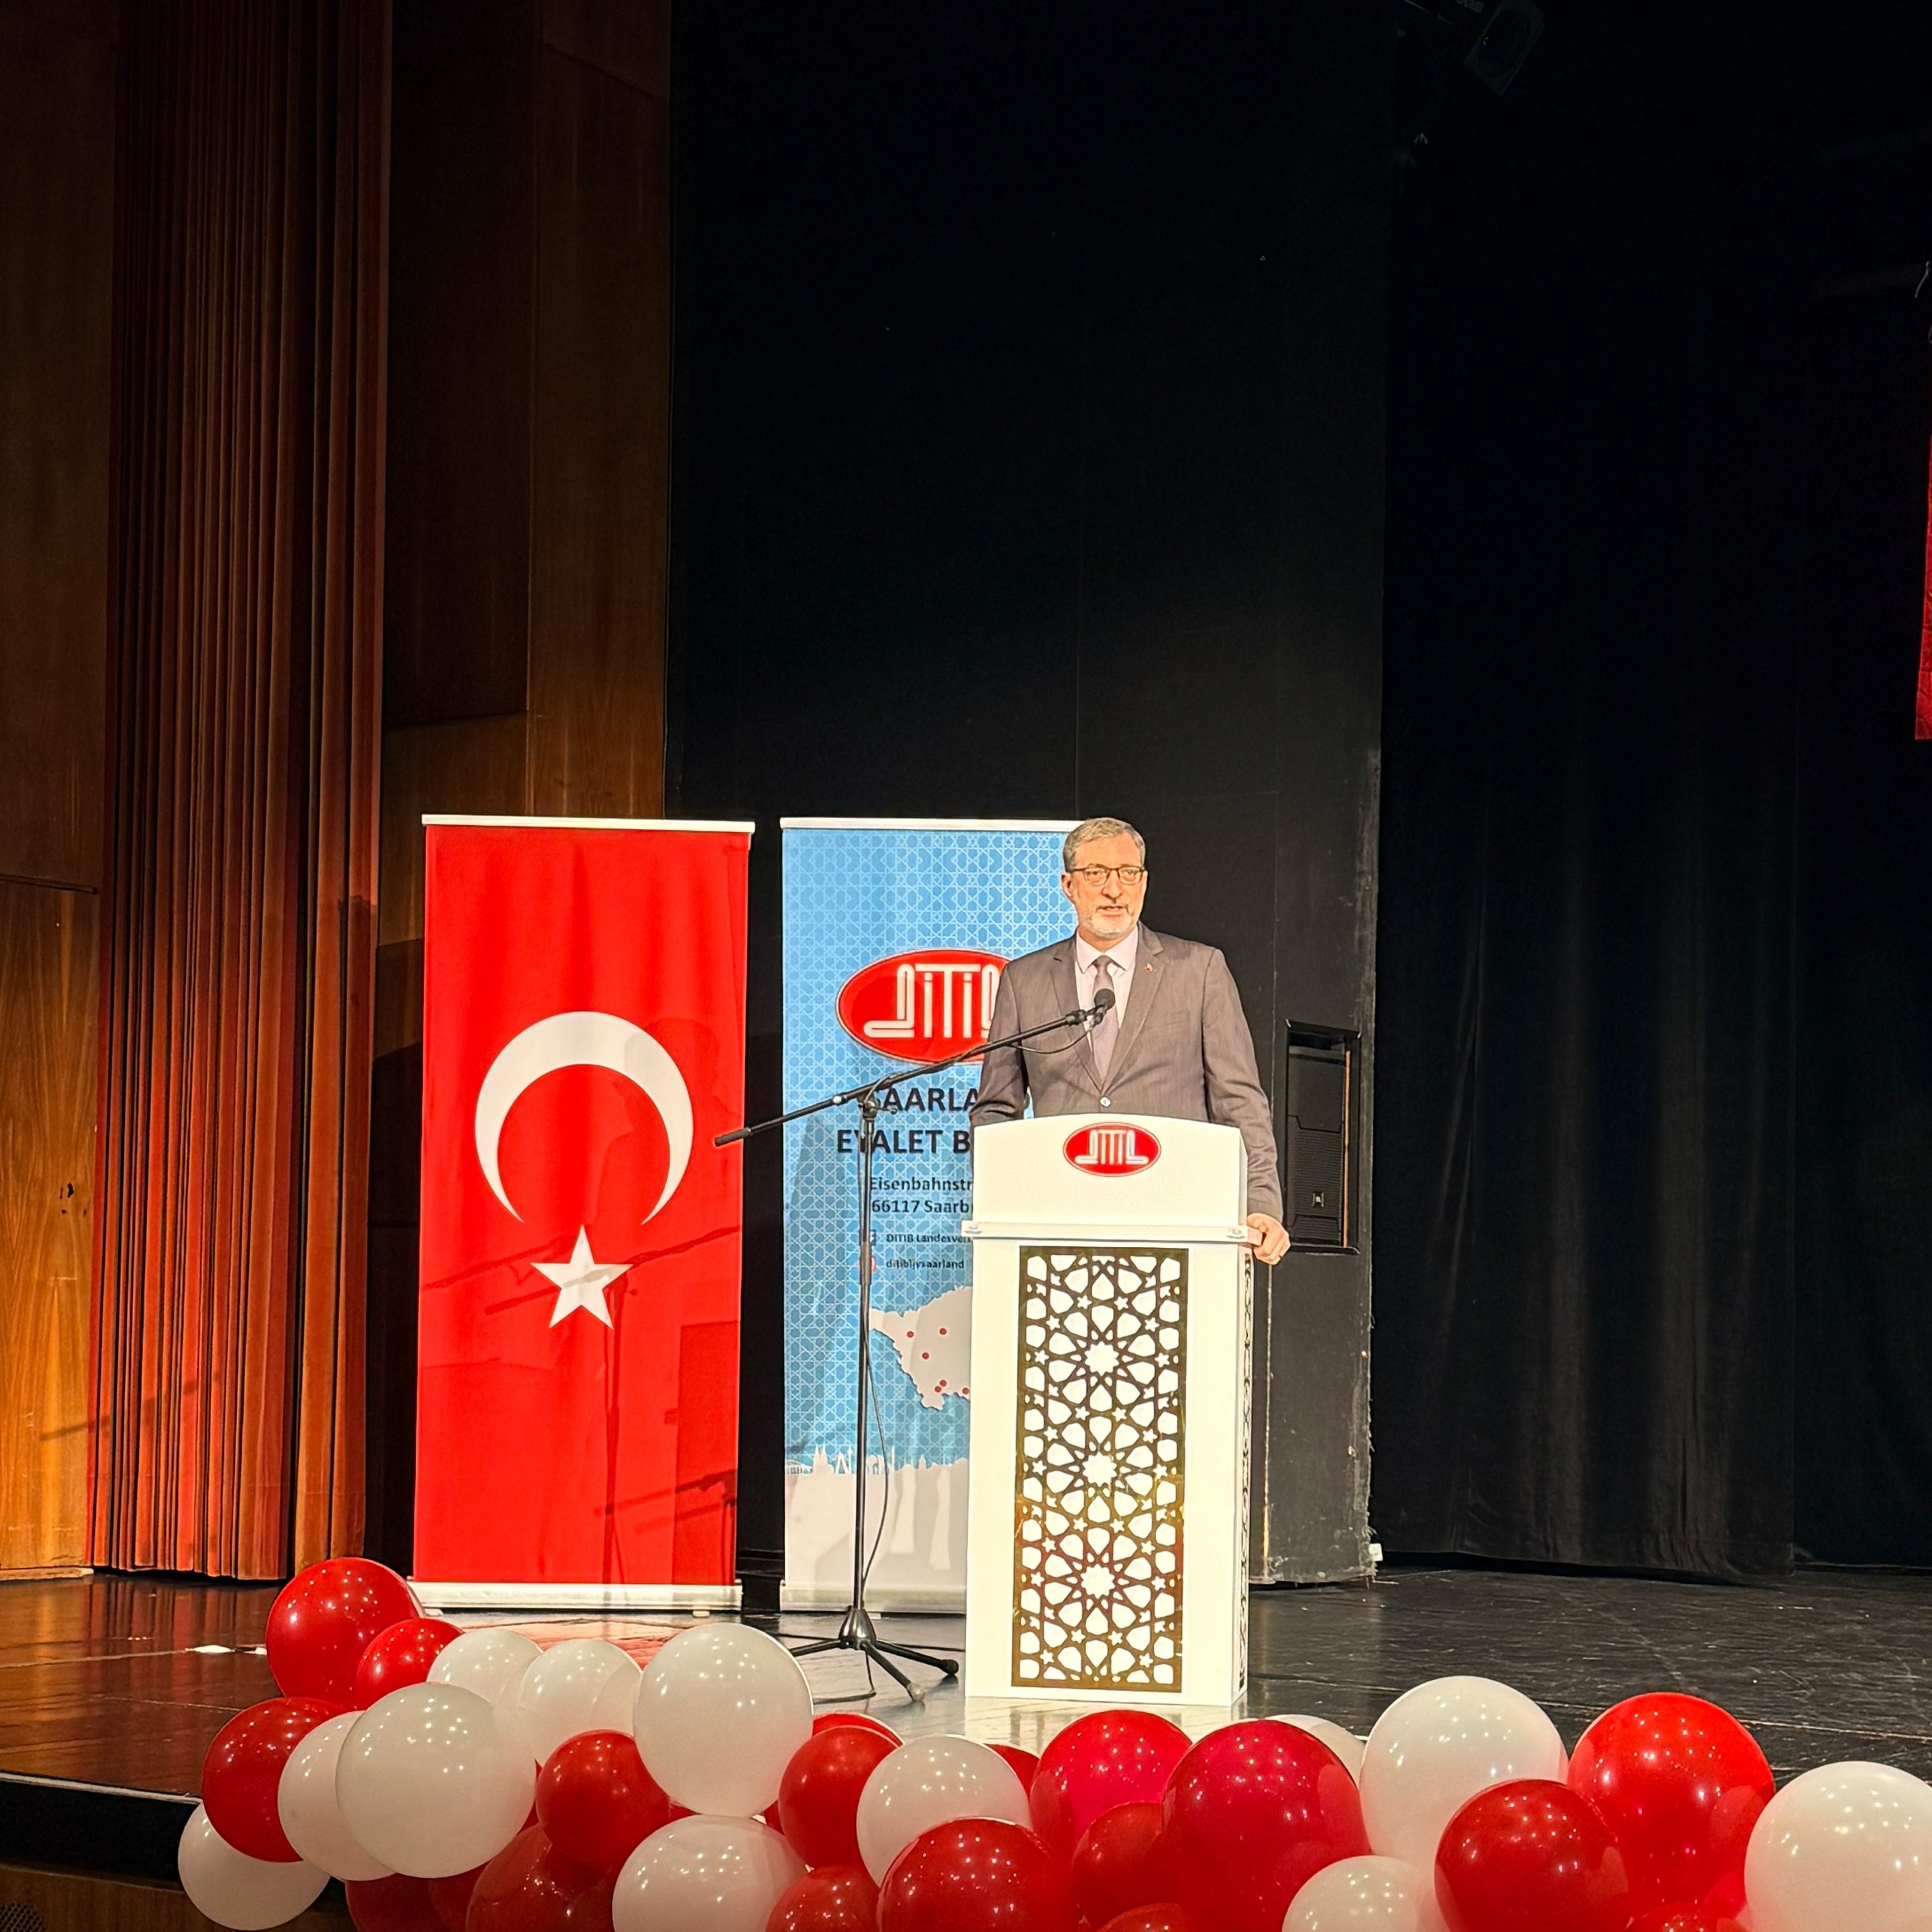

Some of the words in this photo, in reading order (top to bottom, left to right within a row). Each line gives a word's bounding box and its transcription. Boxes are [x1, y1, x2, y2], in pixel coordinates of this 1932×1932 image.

[858, 1088, 978, 1111] AARLA
[872, 1200, 920, 1213] 66117
[924, 1199, 973, 1213] Saarb
[887, 1234, 914, 1243] DITIB
